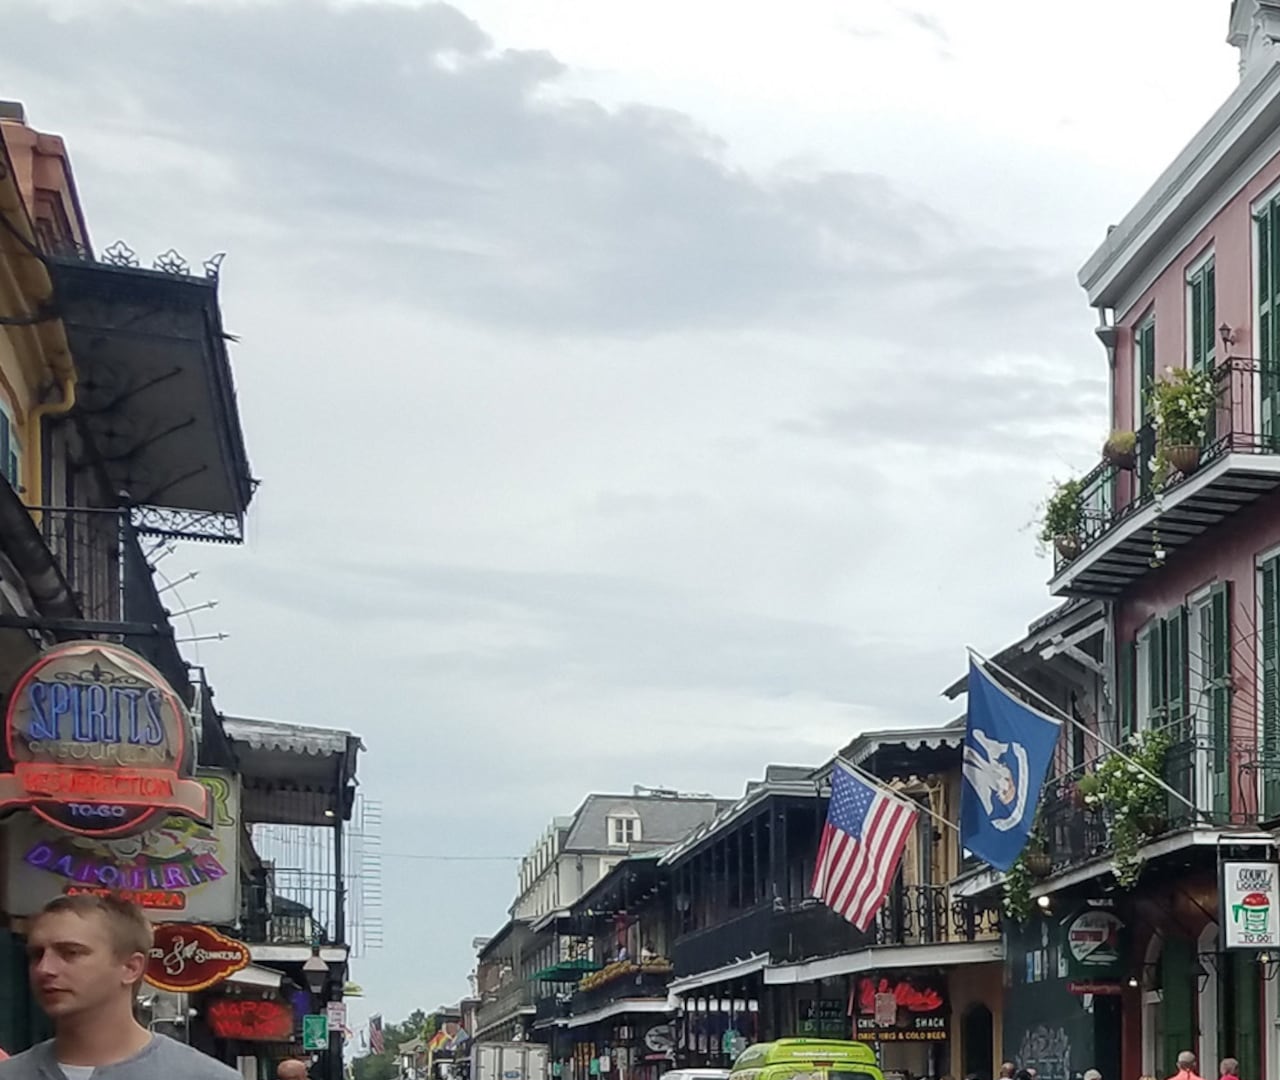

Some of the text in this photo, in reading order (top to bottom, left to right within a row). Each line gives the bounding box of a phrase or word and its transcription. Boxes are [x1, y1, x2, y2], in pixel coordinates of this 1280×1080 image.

[29, 681, 163, 746] SPIRITS
[68, 803, 127, 818] TO-GO
[25, 842, 227, 890] DAIQUIRIS
[1239, 868, 1267, 882] COURT
[1244, 934, 1254, 943] TO
[915, 1017, 945, 1028] SHACK
